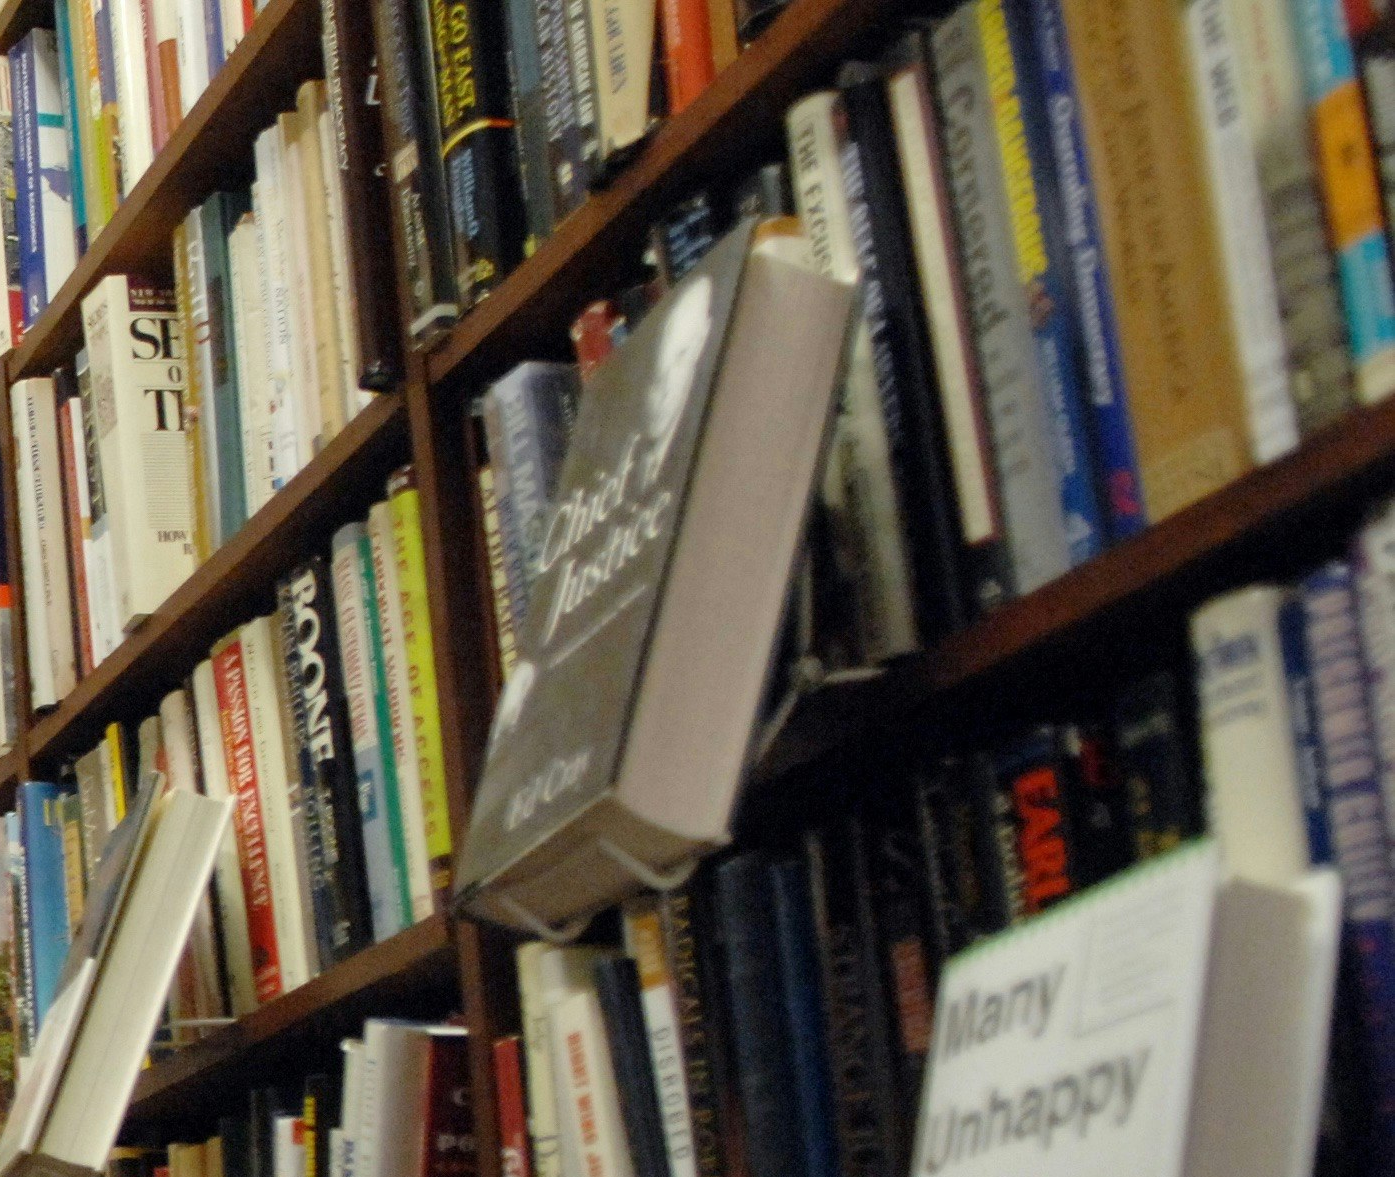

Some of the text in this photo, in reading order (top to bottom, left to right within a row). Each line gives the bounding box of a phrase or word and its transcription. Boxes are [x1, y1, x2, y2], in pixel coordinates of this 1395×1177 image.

[450, 5, 471, 43] GO
[798, 125, 818, 169] THE
[540, 430, 640, 576] Chief
[544, 488, 673, 646] Justice
[399, 590, 417, 646] AGE
[223, 668, 248, 743] PASSION
[407, 664, 424, 697] OF
[234, 744, 255, 786] FOR
[411, 715, 439, 838] ACCESS
[238, 788, 267, 906] EXCELLENCE
[939, 961, 1067, 1064] Many
[922, 1047, 1150, 1175] Unhappy
